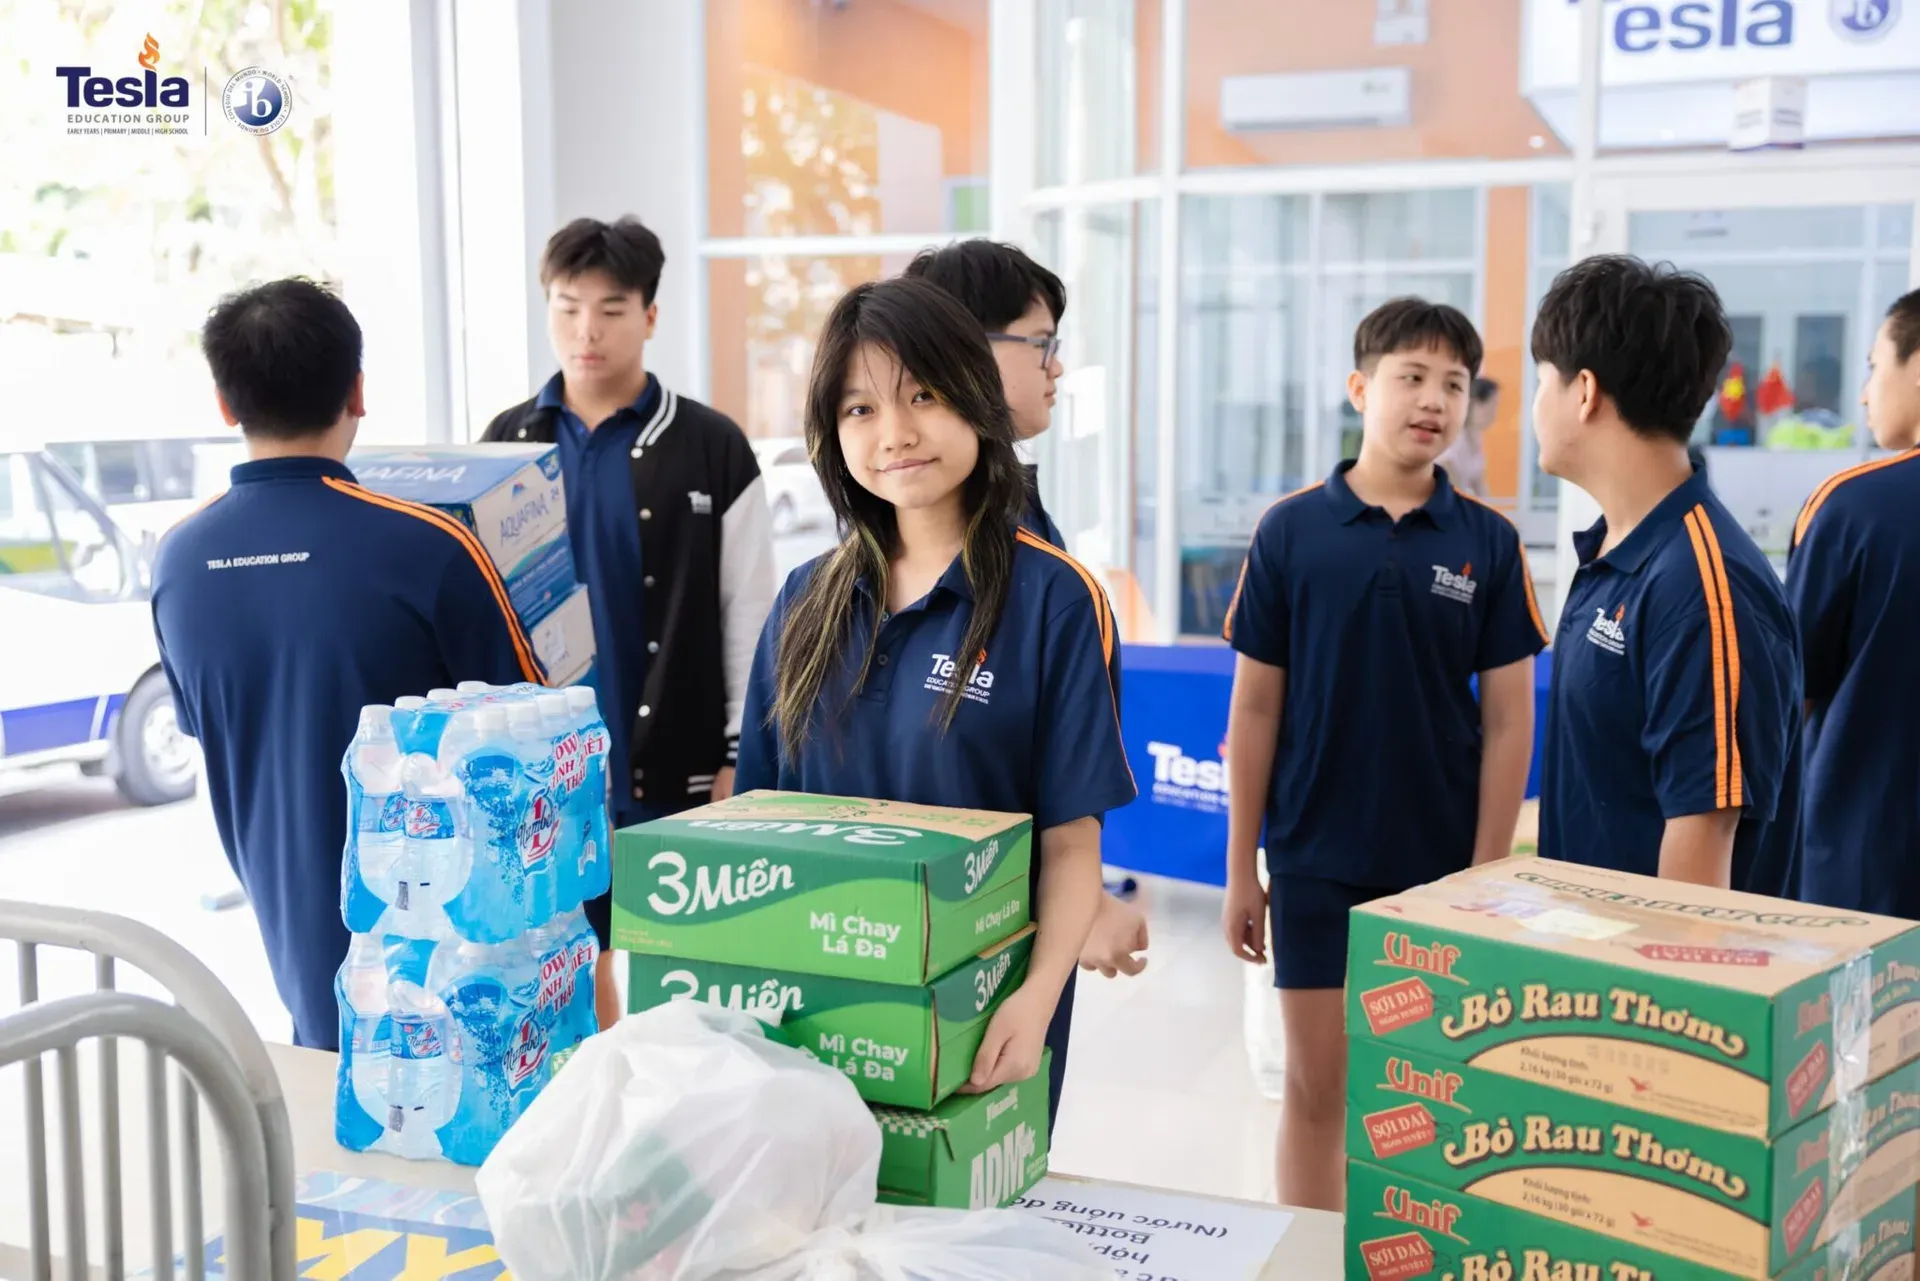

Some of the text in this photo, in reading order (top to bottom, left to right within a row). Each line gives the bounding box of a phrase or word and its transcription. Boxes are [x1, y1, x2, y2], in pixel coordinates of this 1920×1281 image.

[1614, 0, 1794, 52] esla
[233, 554, 279, 567] EDUCATION
[280, 551, 310, 563] GROUP
[1431, 565, 1477, 594] Tesla
[931, 653, 995, 689] Tela
[1147, 741, 1229, 793] Tesl
[810, 911, 902, 943] Mì Chay
[822, 934, 887, 960] Lá Đa
[1384, 931, 1461, 976] Unif
[1395, 986, 1425, 1006] DAI
[1520, 983, 1600, 1019] Rau
[1610, 987, 1746, 1057] Thơm
[819, 1033, 909, 1066] Mì Chay
[832, 1056, 896, 1082] Lá Đa
[1386, 1057, 1464, 1104] Unif
[1398, 1110, 1428, 1131] DAI
[1522, 1115, 1601, 1152] Rau
[1612, 1123, 1747, 1198] Thơm
[1384, 1185, 1462, 1235] Unif
[1395, 1240, 1426, 1260] DAI
[1521, 1249, 1600, 1281] Rau
